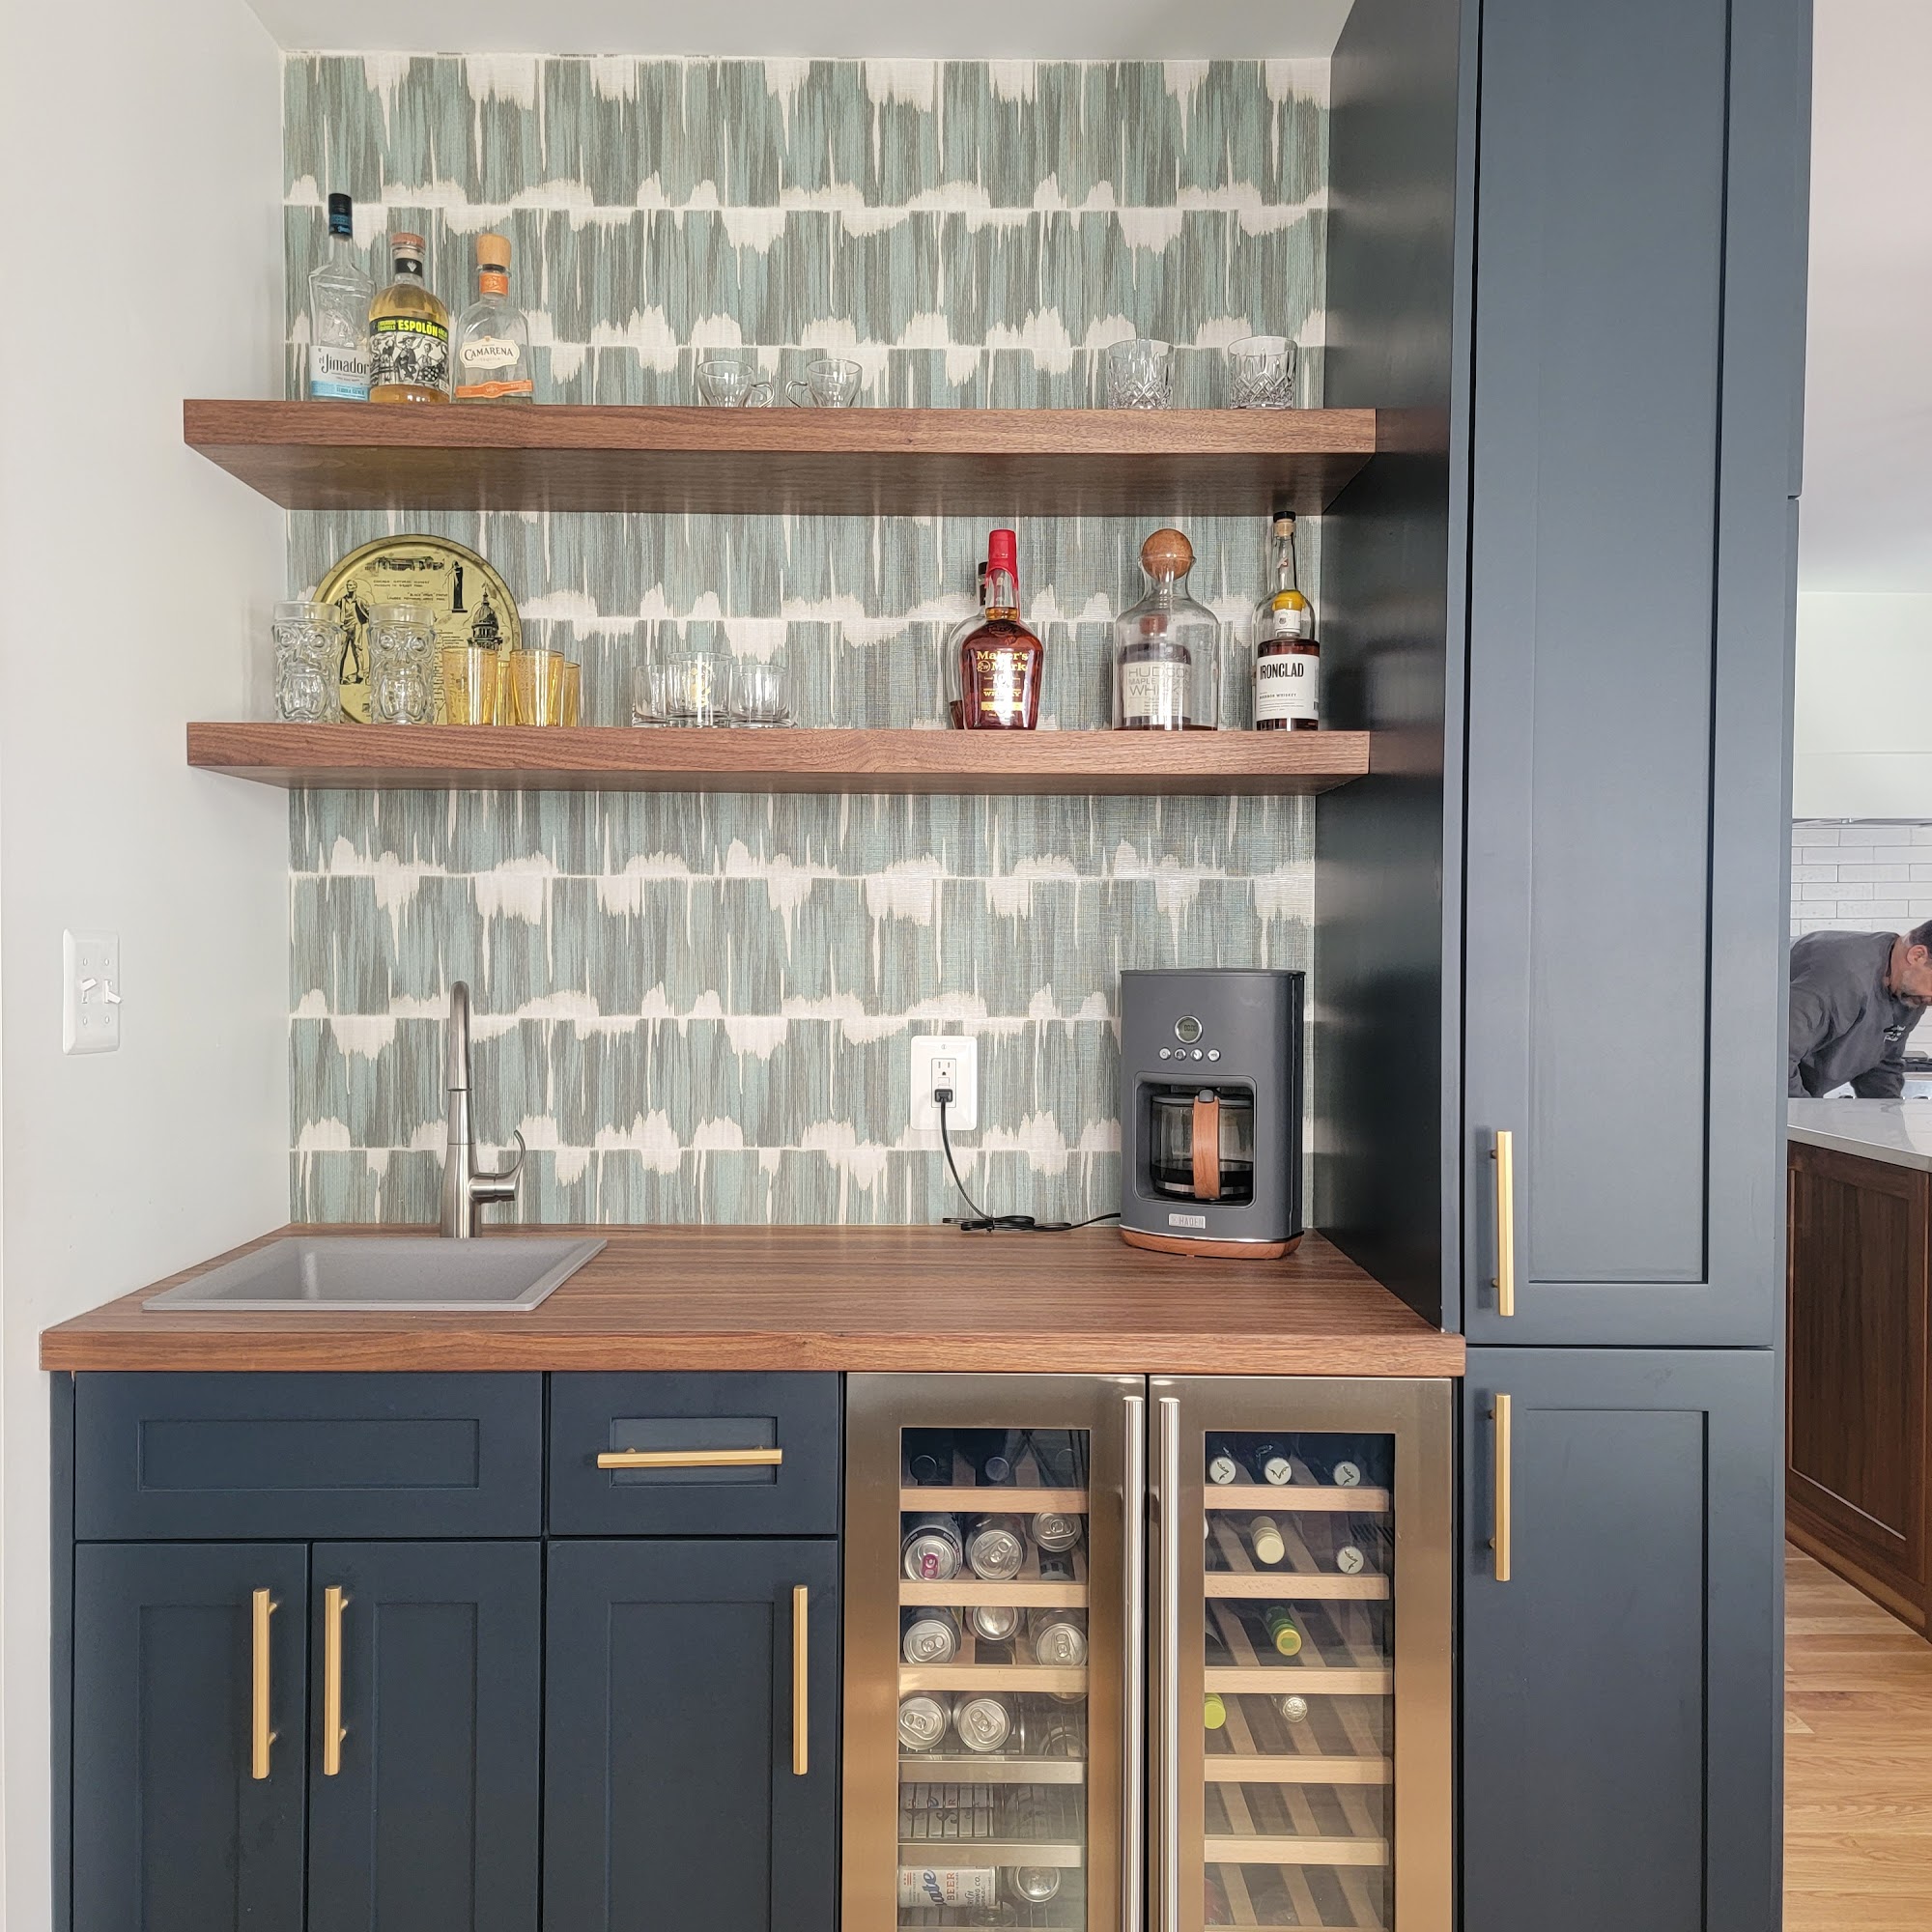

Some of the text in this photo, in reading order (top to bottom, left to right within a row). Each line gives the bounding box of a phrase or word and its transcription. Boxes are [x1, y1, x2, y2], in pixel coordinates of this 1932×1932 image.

[464, 347, 514, 361] CAMARENA
[318, 354, 370, 375] el Jimador
[990, 661, 1027, 671] Mrk
[1260, 663, 1304, 680] IRONCLAD
[1129, 685, 1189, 696] WHIK
[922, 1869, 948, 1907] ate
[947, 1872, 955, 1901] BEER
